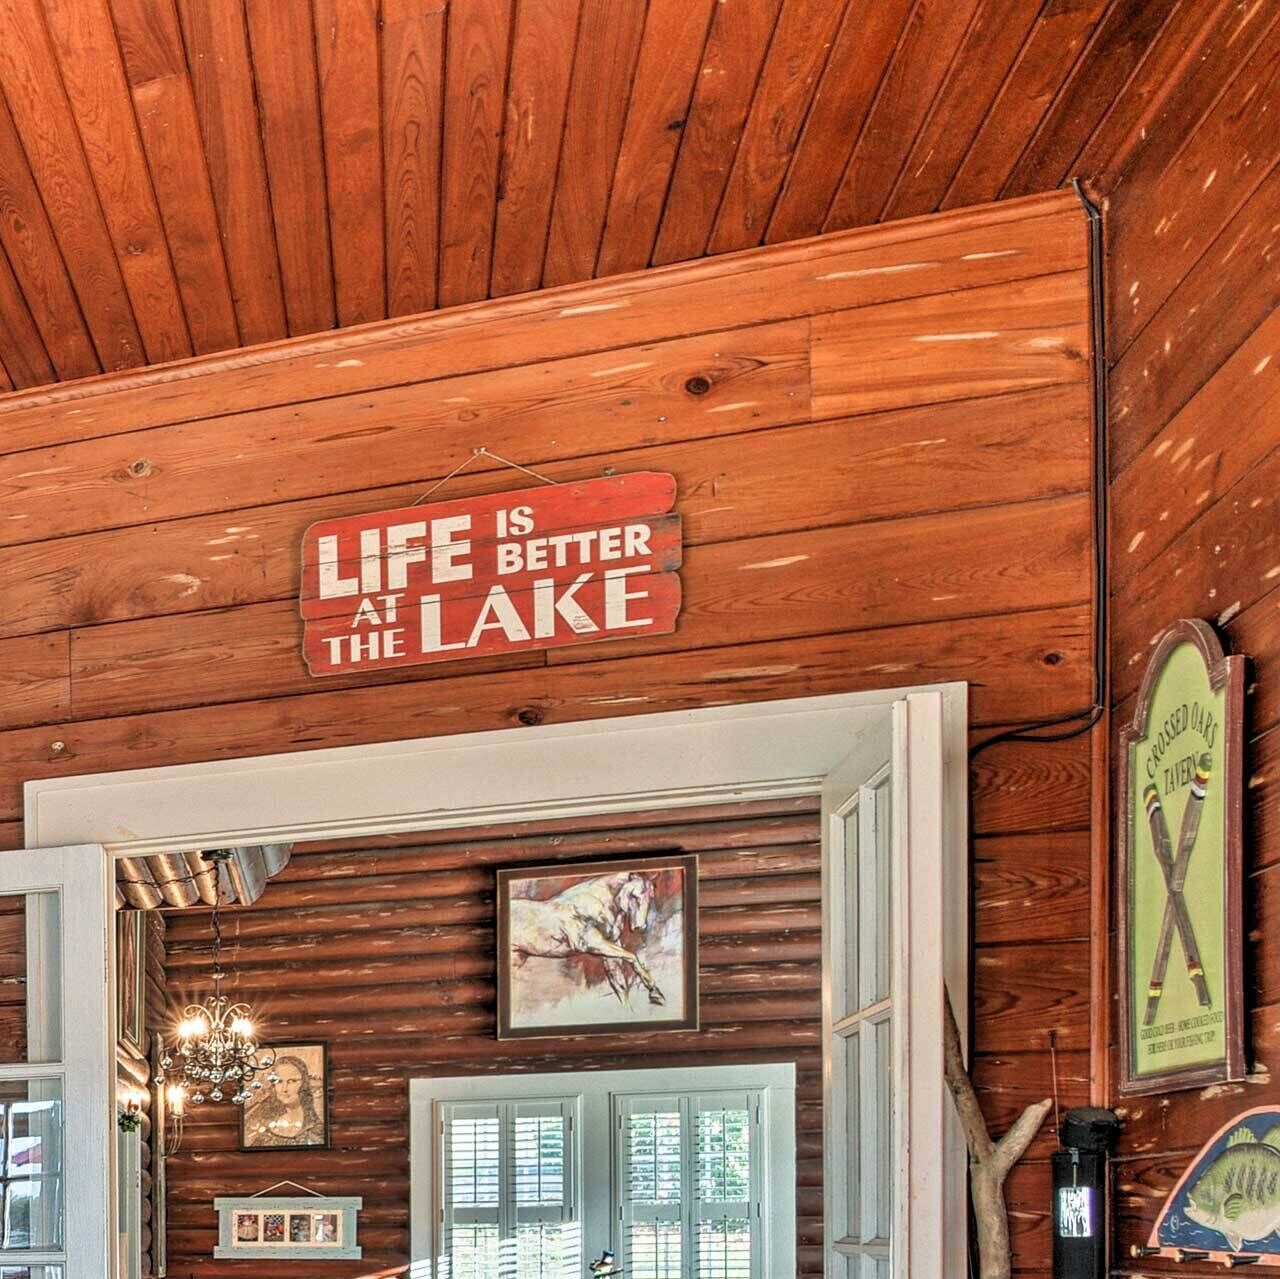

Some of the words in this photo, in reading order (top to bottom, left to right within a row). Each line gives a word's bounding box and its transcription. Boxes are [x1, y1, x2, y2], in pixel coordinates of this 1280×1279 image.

[496, 505, 534, 538] IS
[318, 514, 473, 600] LIFE
[497, 524, 652, 575] BETTER
[351, 593, 405, 629] AT
[421, 565, 653, 654] LAKE
[322, 628, 406, 665] THE
[1146, 704, 1189, 779] CROSSED
[1191, 702, 1218, 749] OARS
